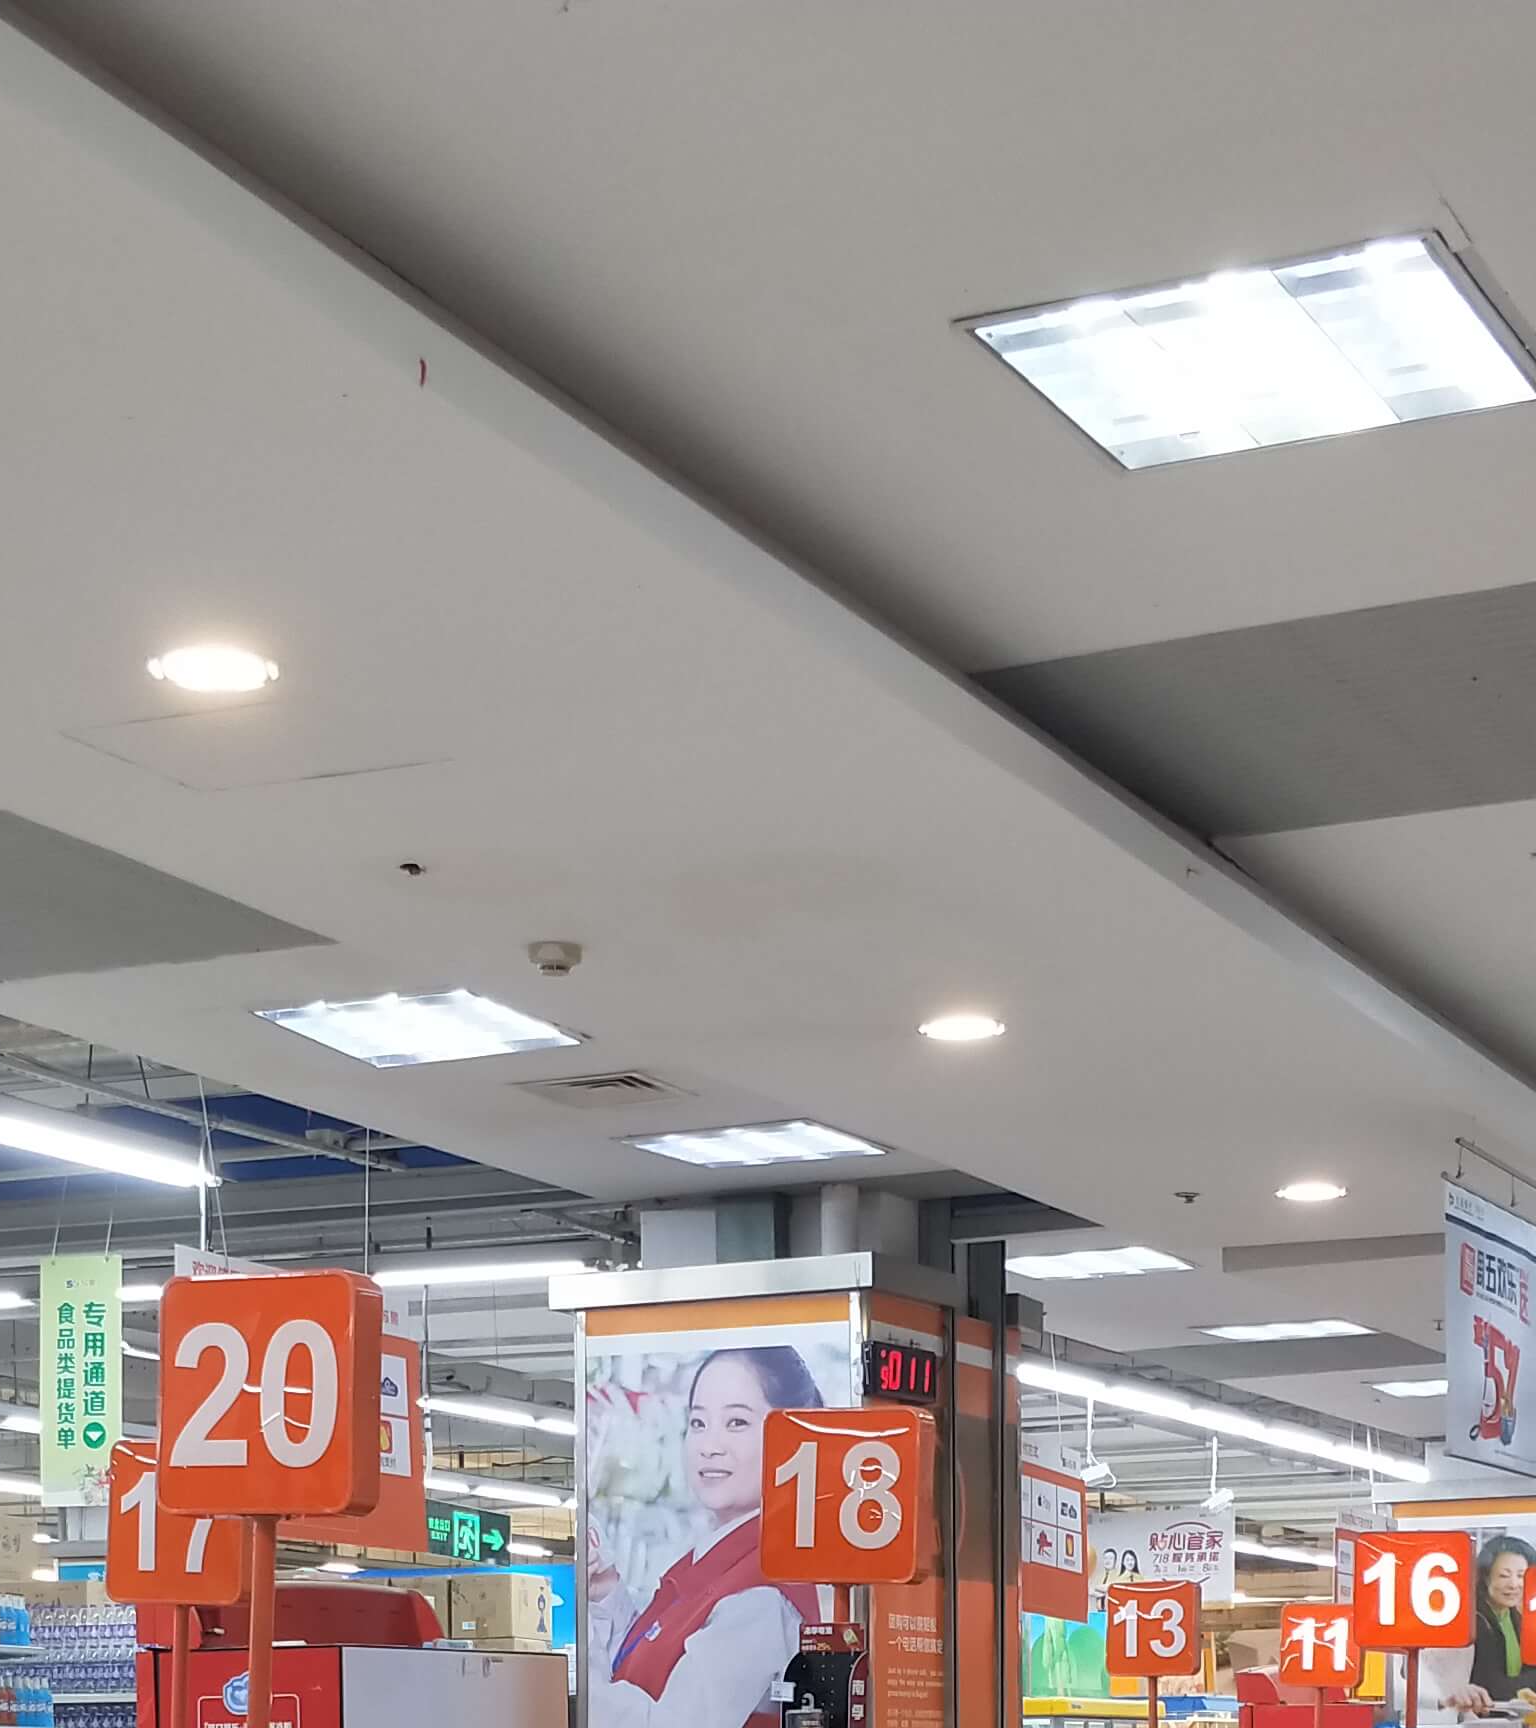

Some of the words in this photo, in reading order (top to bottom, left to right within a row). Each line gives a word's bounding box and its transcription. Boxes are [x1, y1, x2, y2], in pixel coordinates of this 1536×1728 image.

[56, 1301, 77, 1450] 食品类提货单
[82, 1301, 107, 1417] 专用通道
[169, 1318, 339, 1468] 20
[774, 1441, 902, 1550] 18
[431, 1530, 448, 1542] EXIT
[1149, 1530, 1224, 1552] 贴心管家
[1362, 1552, 1460, 1627] 16
[1113, 1598, 1187, 1658] 13
[1290, 1616, 1349, 1672] 11
